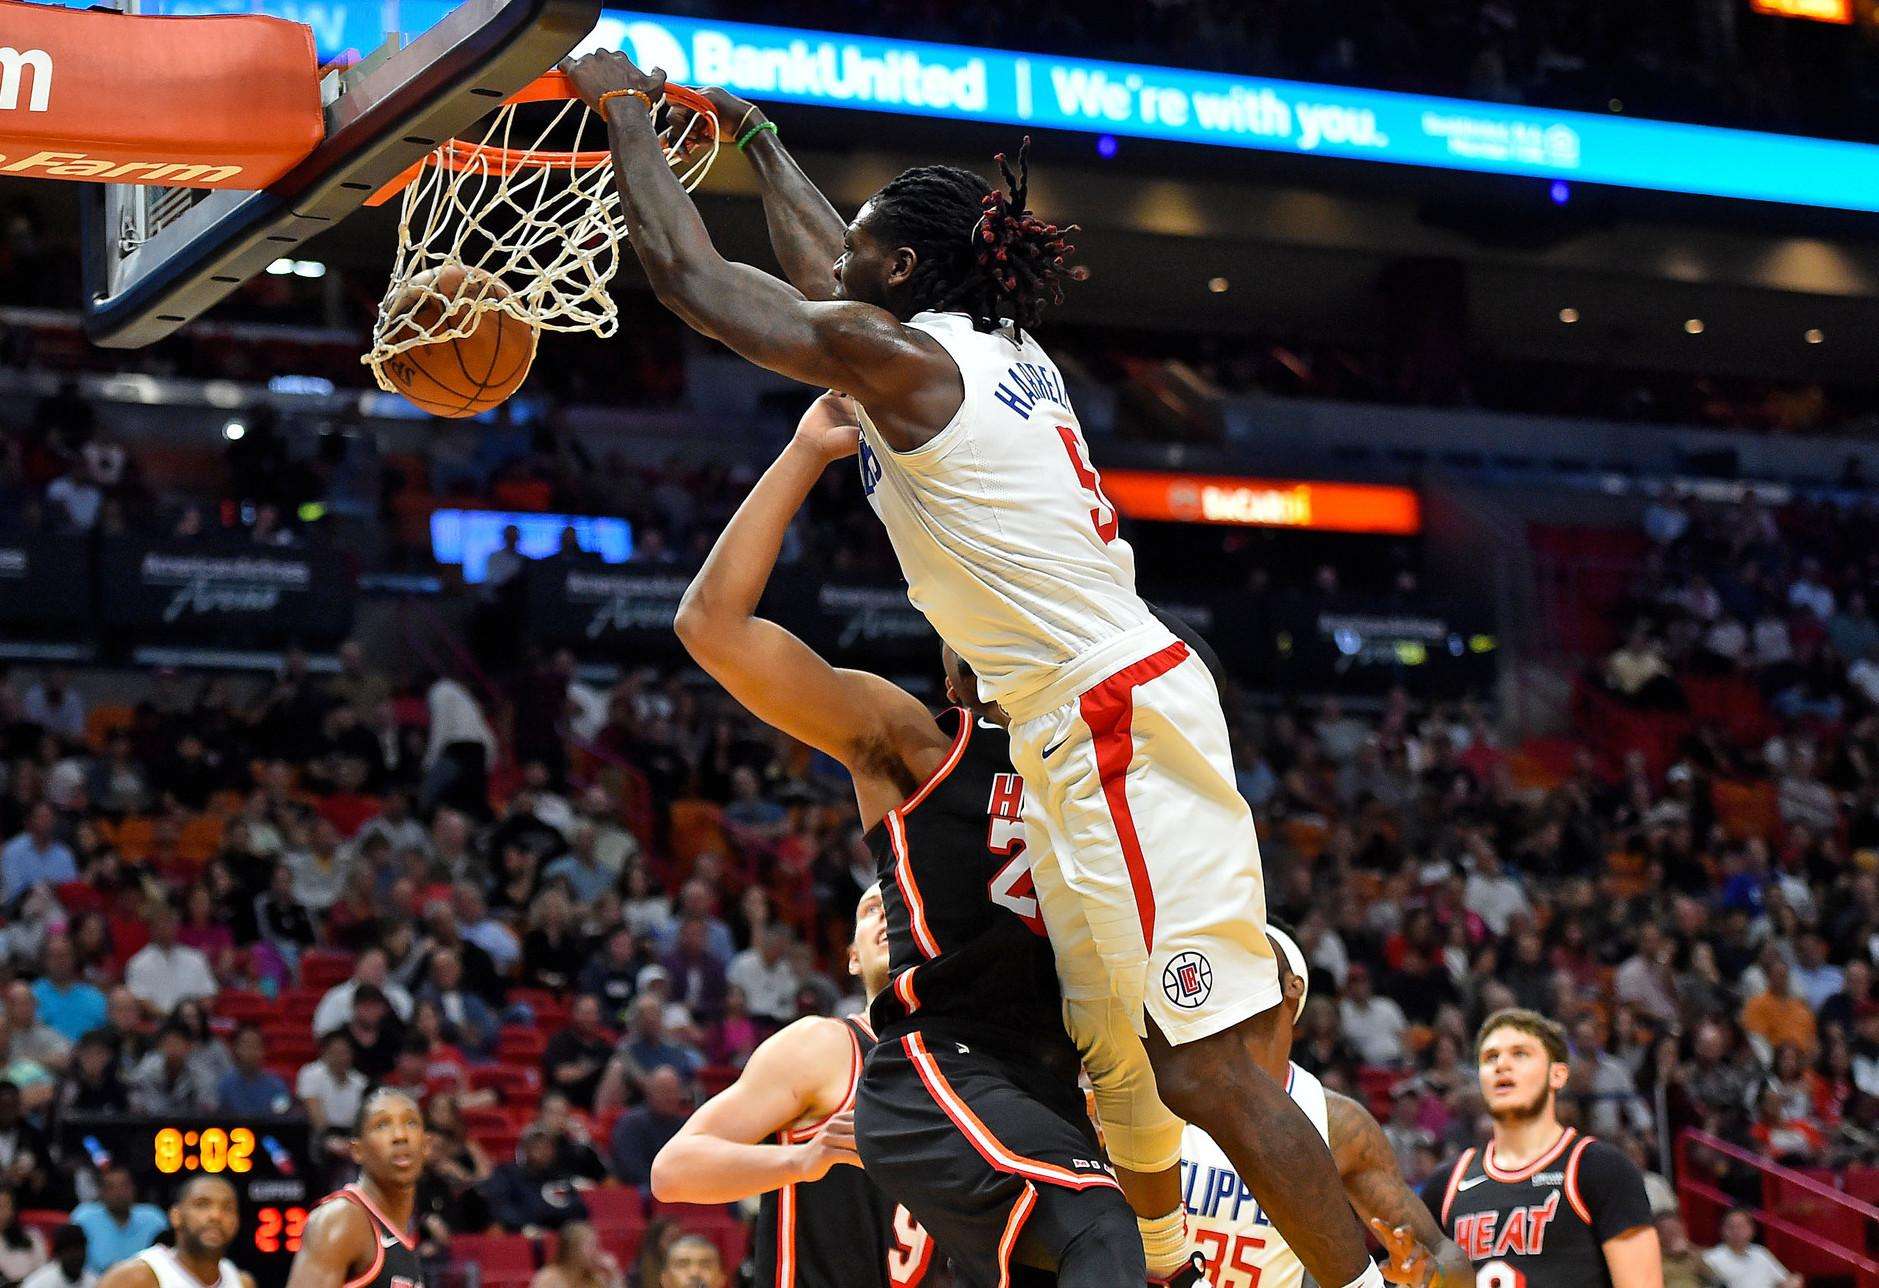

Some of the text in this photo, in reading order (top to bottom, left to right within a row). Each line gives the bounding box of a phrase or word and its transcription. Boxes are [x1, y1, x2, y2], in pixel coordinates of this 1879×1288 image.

[692, 30, 987, 113] BankUnited
[1050, 66, 1189, 127] We're
[1192, 85, 1292, 138] with
[1296, 102, 1390, 151] you.
[0, 150, 243, 183] Farm
[1055, 425, 1119, 546] 5
[155, 1127, 256, 1174] 8:02
[1194, 1228, 1266, 1288] 35
[1454, 1188, 1561, 1262] HEAT
